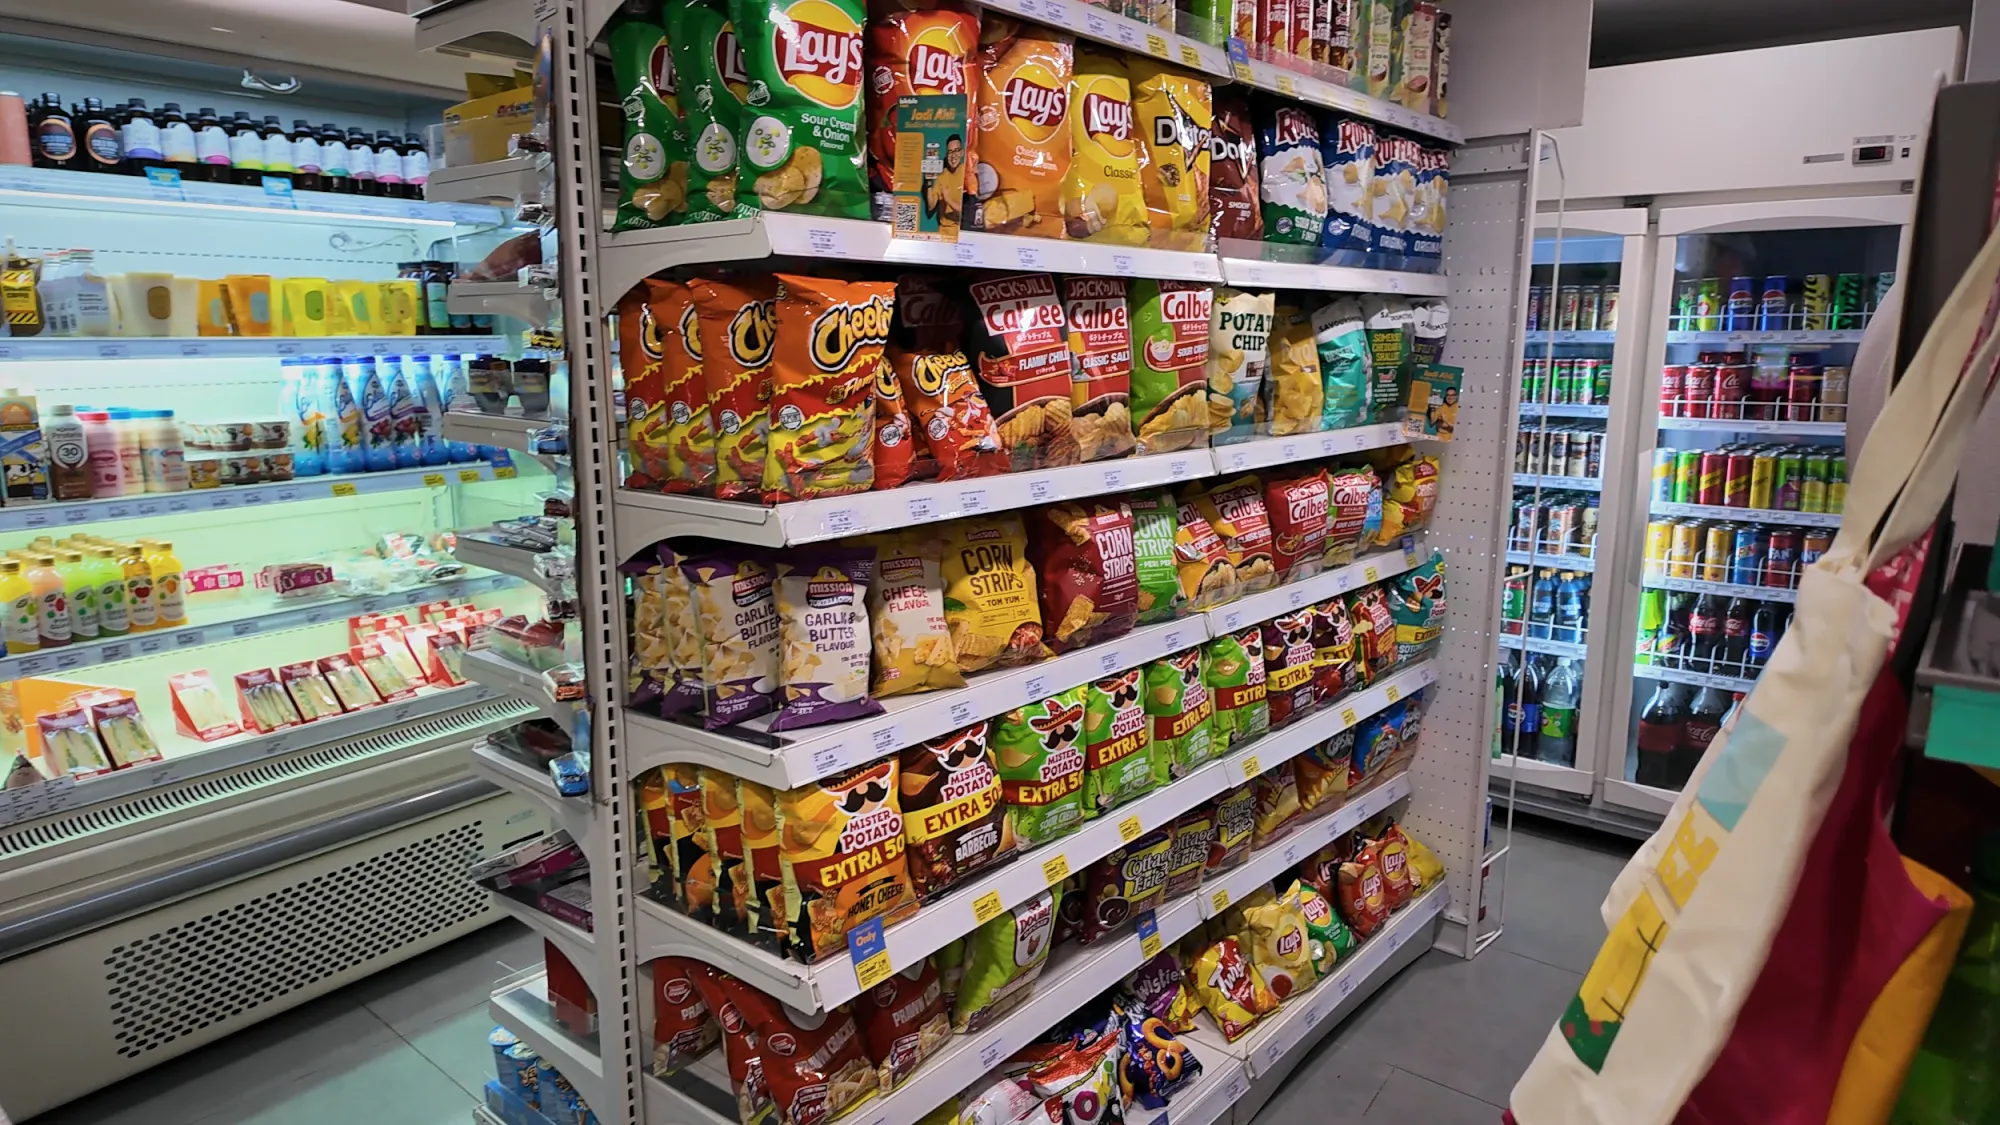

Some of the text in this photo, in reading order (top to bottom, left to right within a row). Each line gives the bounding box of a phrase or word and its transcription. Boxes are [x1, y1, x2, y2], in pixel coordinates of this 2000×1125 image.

[783, 20, 864, 84] Lay's
[1010, 79, 1064, 126] Lay's
[801, 112, 827, 127] Sour
[1088, 94, 1132, 141] Lay's
[813, 125, 850, 143] & Onion
[987, 300, 1062, 332] Calbee
[1232, 335, 1266, 351] CHIP
[1083, 354, 1109, 369] CLASSIC
[1220, 499, 1267, 521] Calbee
[1292, 498, 1328, 521] Calbee
[1096, 527, 1133, 560] CORN
[961, 544, 1013, 575] CORN
[1103, 554, 1135, 580] STRIPS
[883, 585, 928, 601] CHEESE
[970, 573, 1024, 595] STRIPS
[988, 595, 1020, 607] TOM YUM
[735, 604, 775, 627] GARLIC
[740, 615, 782, 640] BUTTER
[809, 627, 856, 641] BUTTER
[816, 640, 855, 652] FLAVOUR
[1278, 669, 1308, 689] EXTRA
[1183, 689, 1206, 713] POTATO
[1116, 707, 1141, 722] MISTER
[1173, 701, 1211, 736] EXTRA 50
[1048, 748, 1077, 765] MISTER
[1098, 728, 1148, 765] EXTRA 5
[951, 765, 986, 786] MISTER
[1041, 755, 1083, 780] POTATO
[944, 771, 993, 801] POTATO
[1019, 776, 1067, 803] EXTRA
[850, 810, 890, 833] MISTER
[924, 798, 981, 834] EXTRA
[1218, 796, 1257, 826] Cottage
[843, 817, 900, 850] POTATO
[1174, 828, 1216, 851] ottage
[1228, 818, 1255, 841] Fries
[955, 830, 998, 862] BARBECUE
[820, 833, 905, 888] EXTRA 50
[1384, 851, 1406, 874] Lay's
[1363, 873, 1382, 898] Lay's
[1304, 897, 1325, 923] Lay's
[856, 931, 877, 947] Only
[892, 997, 925, 1028] PRAWN
